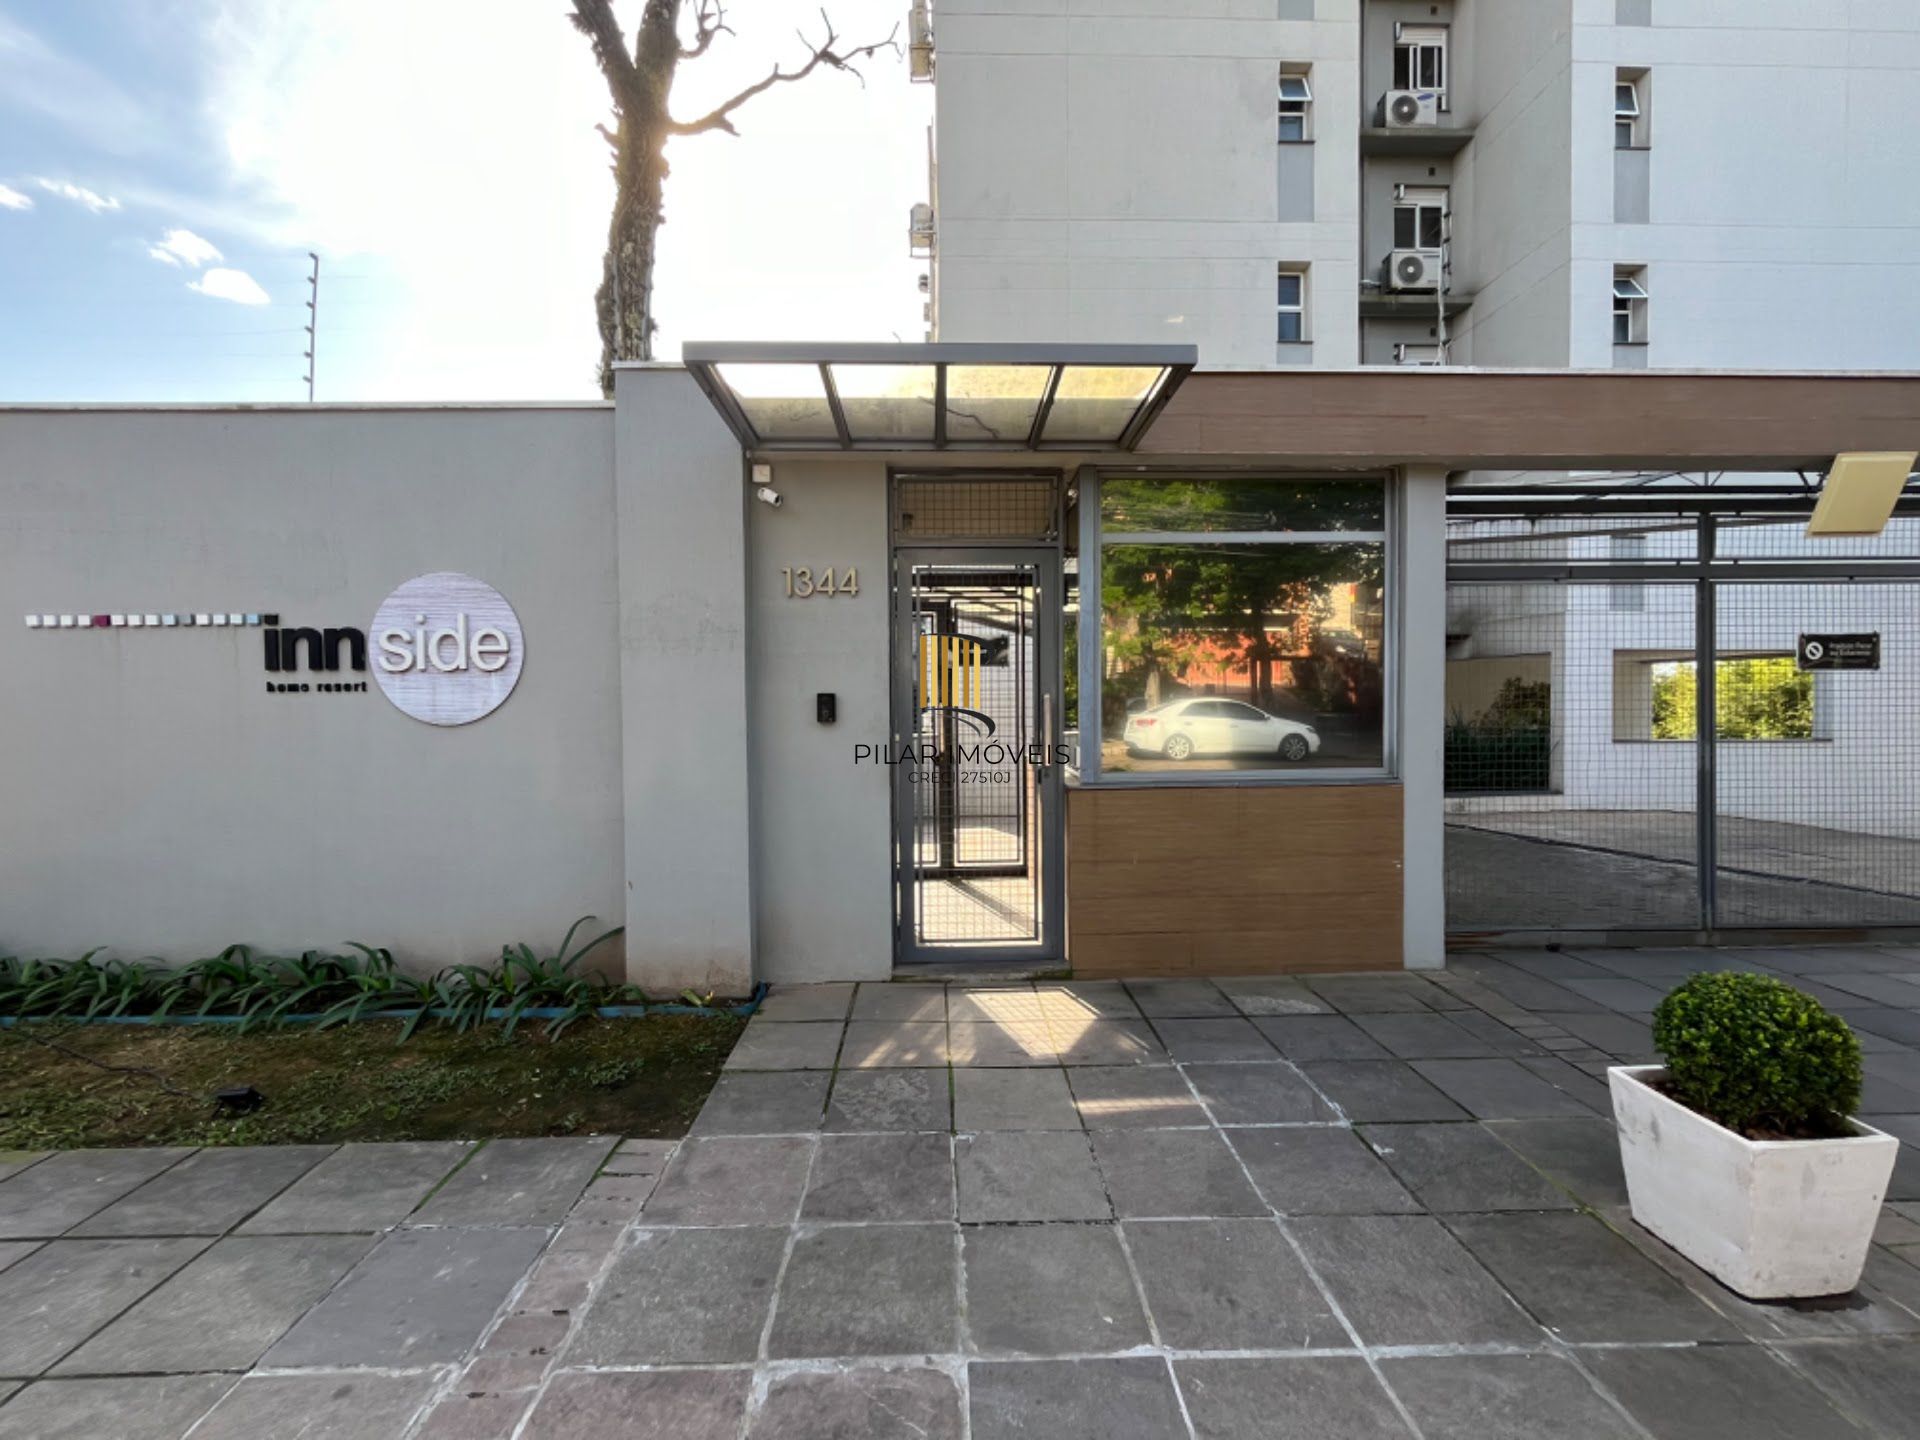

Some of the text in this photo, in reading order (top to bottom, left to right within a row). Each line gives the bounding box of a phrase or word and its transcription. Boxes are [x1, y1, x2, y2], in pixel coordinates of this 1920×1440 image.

[781, 566, 859, 598] 1344
[264, 612, 511, 673] inn side
[266, 681, 310, 693] home
